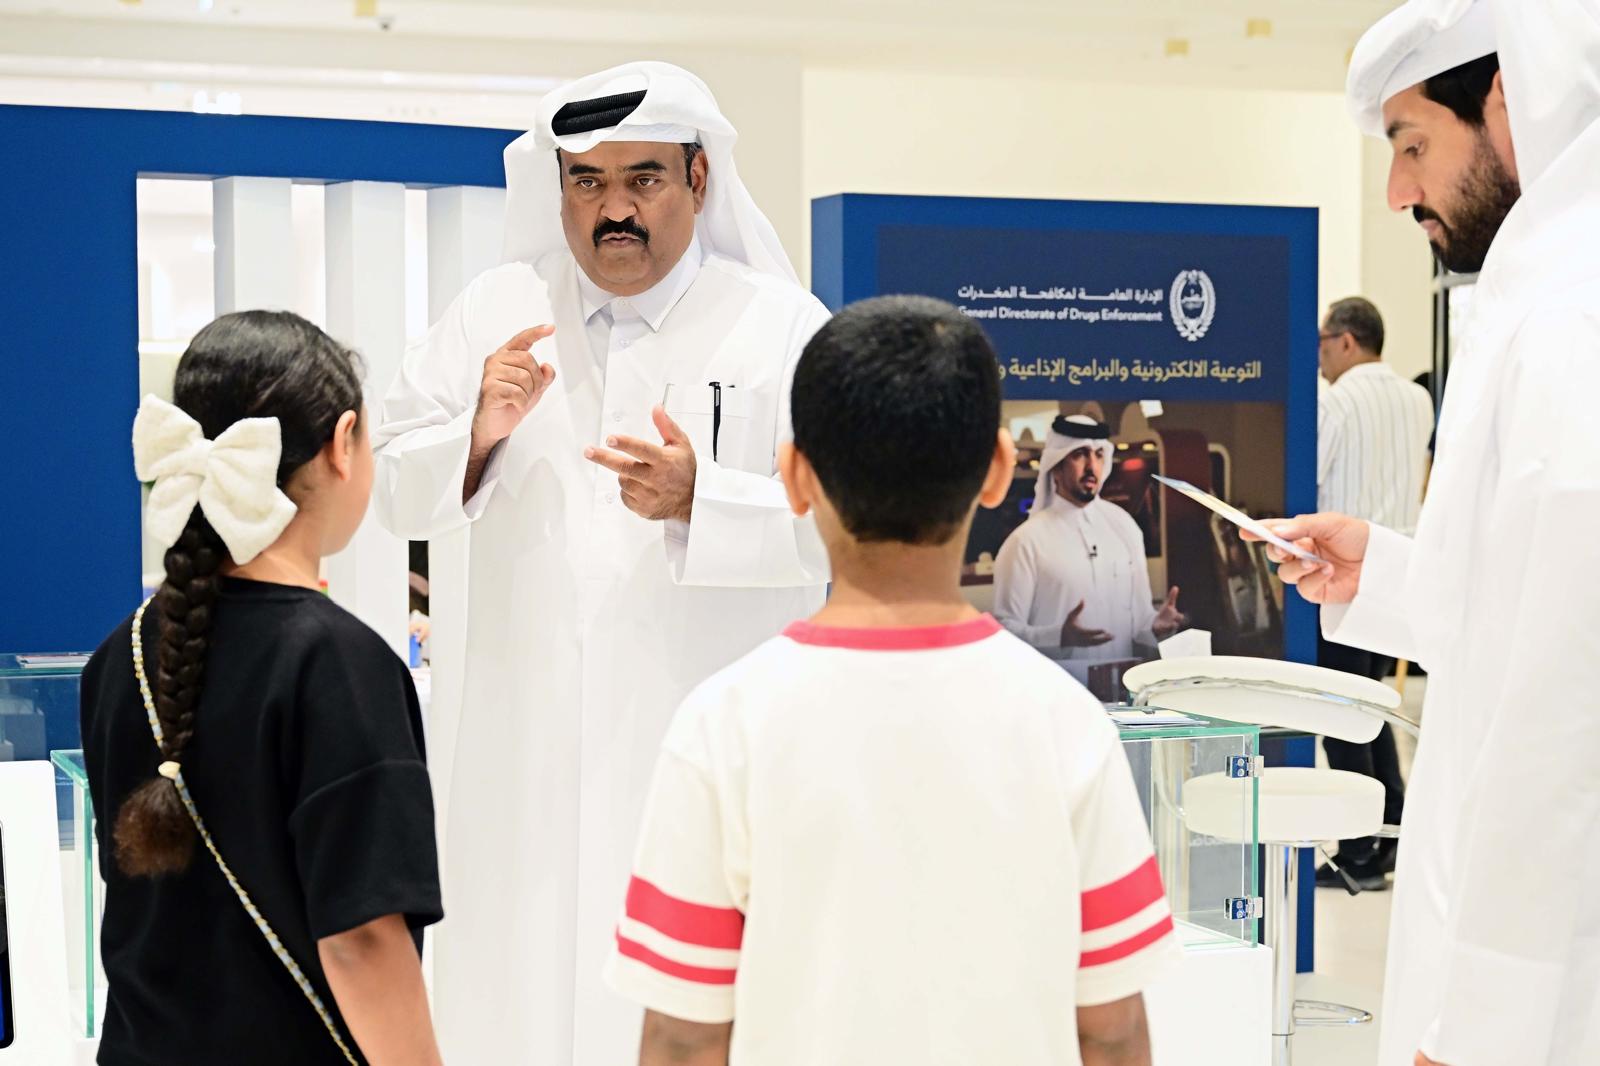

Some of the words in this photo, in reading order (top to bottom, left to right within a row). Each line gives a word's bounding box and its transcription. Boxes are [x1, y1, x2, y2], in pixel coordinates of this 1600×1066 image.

[1135, 288, 1163, 305] الإدارة
[998, 306, 1056, 320] Directorate
[1057, 307, 1068, 320] of
[1069, 307, 1100, 323] Drugs
[1101, 308, 1163, 322] Enforcement
[1008, 357, 1066, 382] الإذاعية
[1068, 358, 1129, 385] والبرامج
[1131, 358, 1208, 382] الالكترونية
[1210, 359, 1261, 383] التوعية
